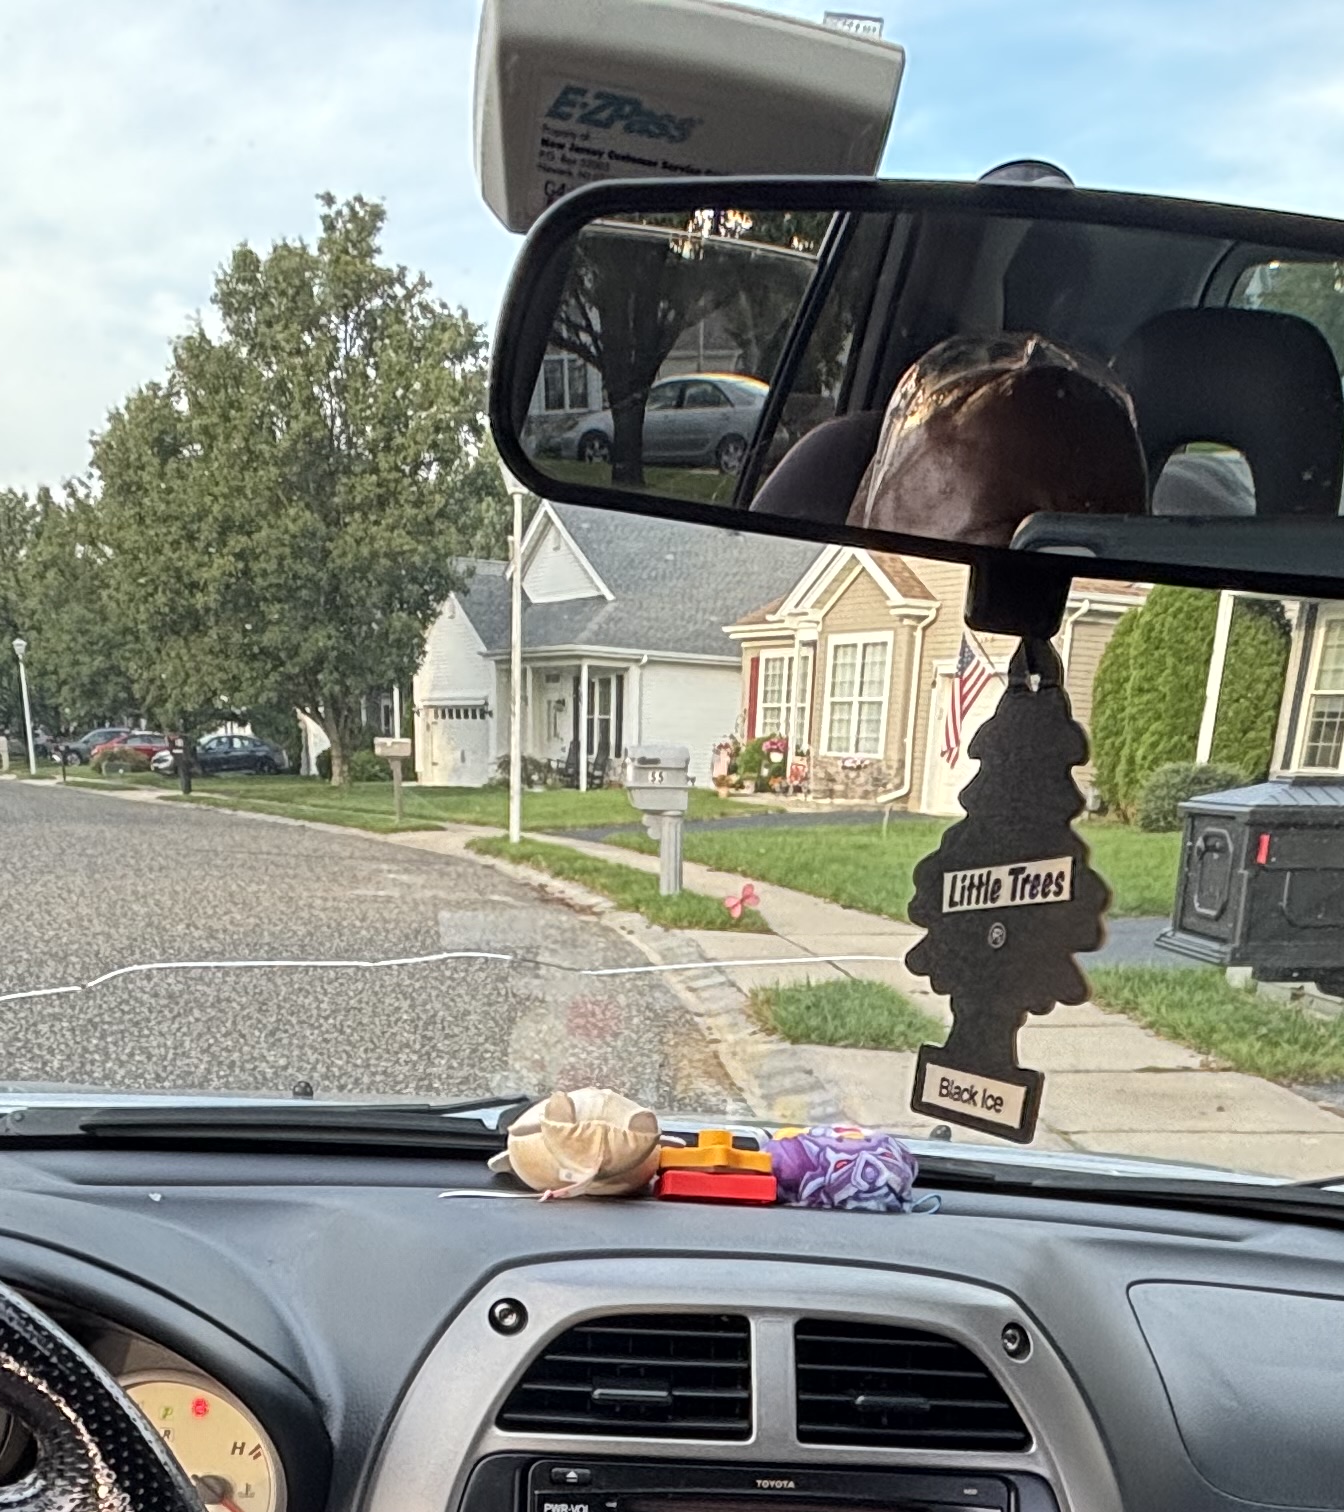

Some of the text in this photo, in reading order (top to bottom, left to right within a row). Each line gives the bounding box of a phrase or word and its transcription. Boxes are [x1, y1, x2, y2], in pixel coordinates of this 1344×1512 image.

[948, 866, 1066, 909] Little Trees
[938, 1076, 1004, 1114] Black Ice
[231, 1441, 246, 1456] H
[756, 1479, 796, 1489] TOYOTA
